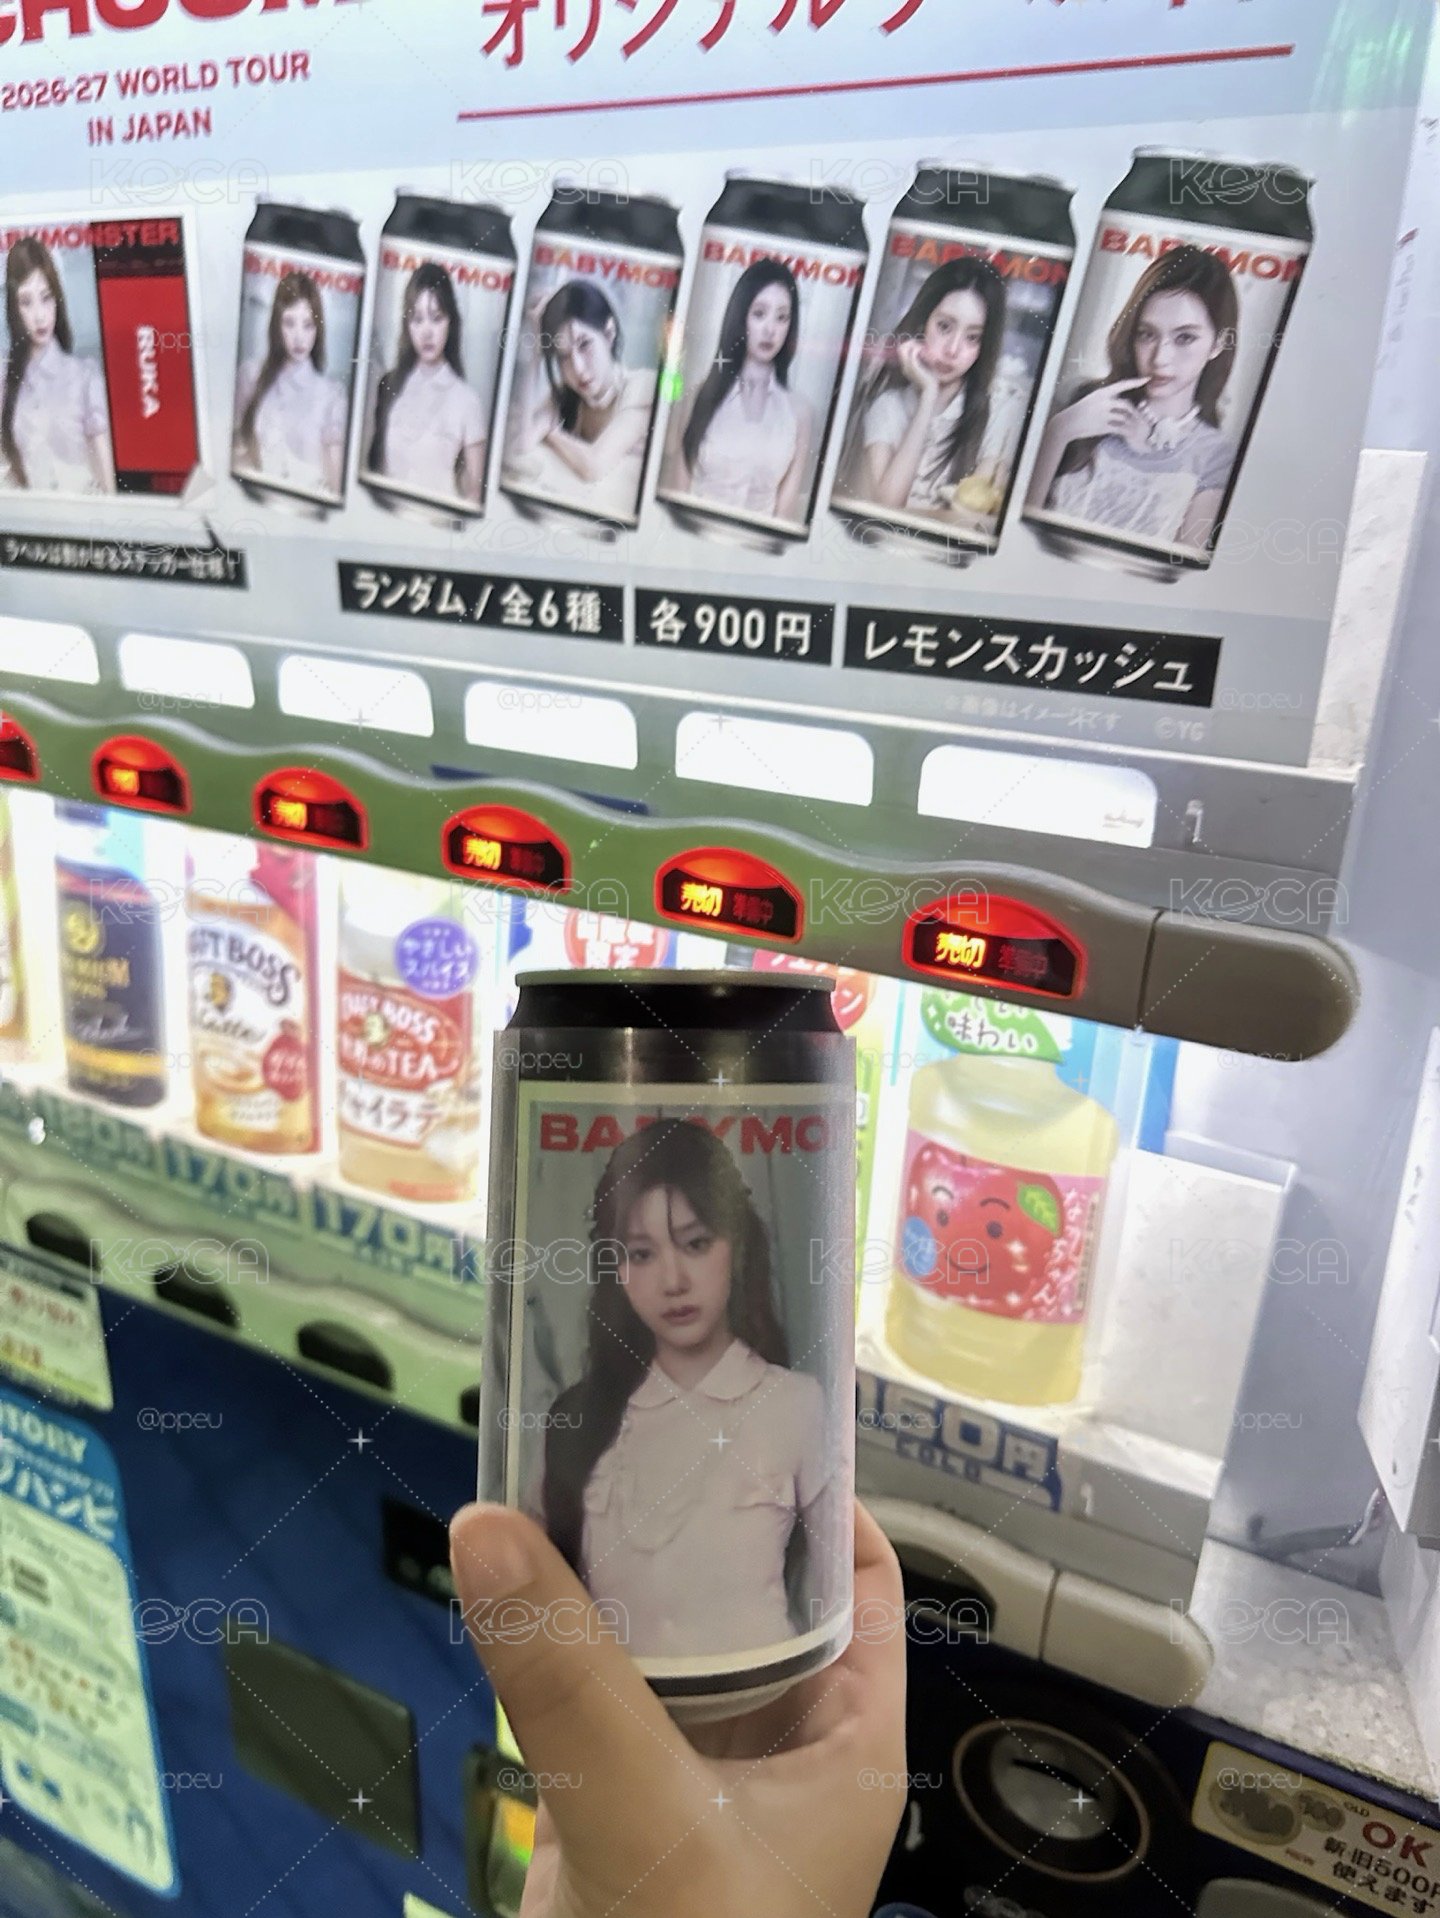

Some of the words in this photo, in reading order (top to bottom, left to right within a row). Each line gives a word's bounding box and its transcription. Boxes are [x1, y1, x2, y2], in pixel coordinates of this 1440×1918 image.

[1, 71, 108, 112] 2026-27
[116, 60, 219, 99] WORLD
[226, 50, 312, 88] TOUR
[87, 116, 113, 146] IN
[121, 107, 213, 143] JAPAN
[650, 598, 812, 655] 各900円
[865, 621, 1193, 693] レモンスカッシュ
[681, 883, 723, 917] 売切
[935, 932, 986, 968] 売切
[946, 1012, 1034, 1048] 味わい
[0, 1400, 87, 1464] TORY
[1362, 1821, 1434, 1868] OK
[1332, 1860, 1435, 1913] 使えます
